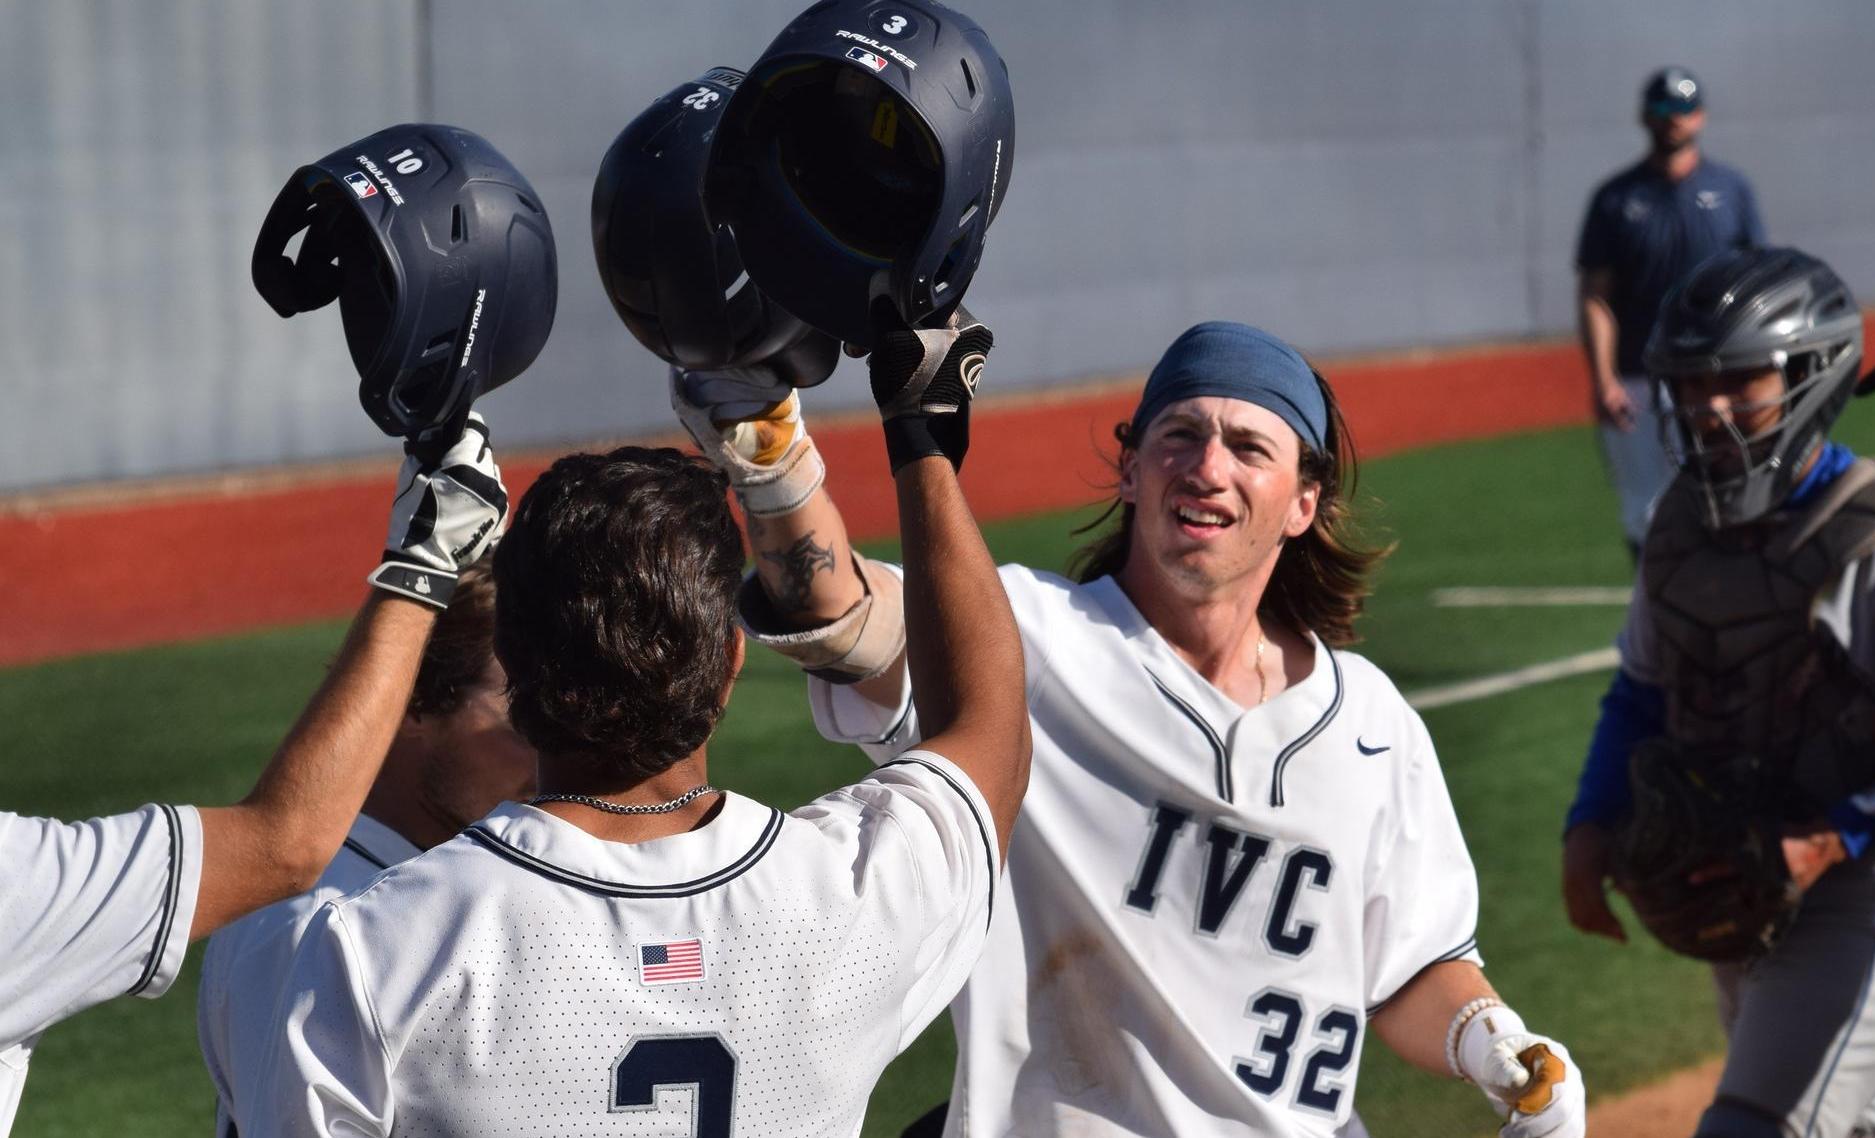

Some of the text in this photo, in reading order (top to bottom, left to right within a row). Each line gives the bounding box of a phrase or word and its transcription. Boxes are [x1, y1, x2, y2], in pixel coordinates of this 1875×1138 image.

[882, 15, 908, 34] 3
[835, 30, 918, 71] RAWLINGS
[682, 87, 720, 110] 32
[356, 155, 405, 206] RAWLINGS
[387, 148, 422, 174] 10
[461, 289, 486, 367] RAWLINGS
[1122, 803, 1335, 961] IVC
[1231, 986, 1360, 1120] 32
